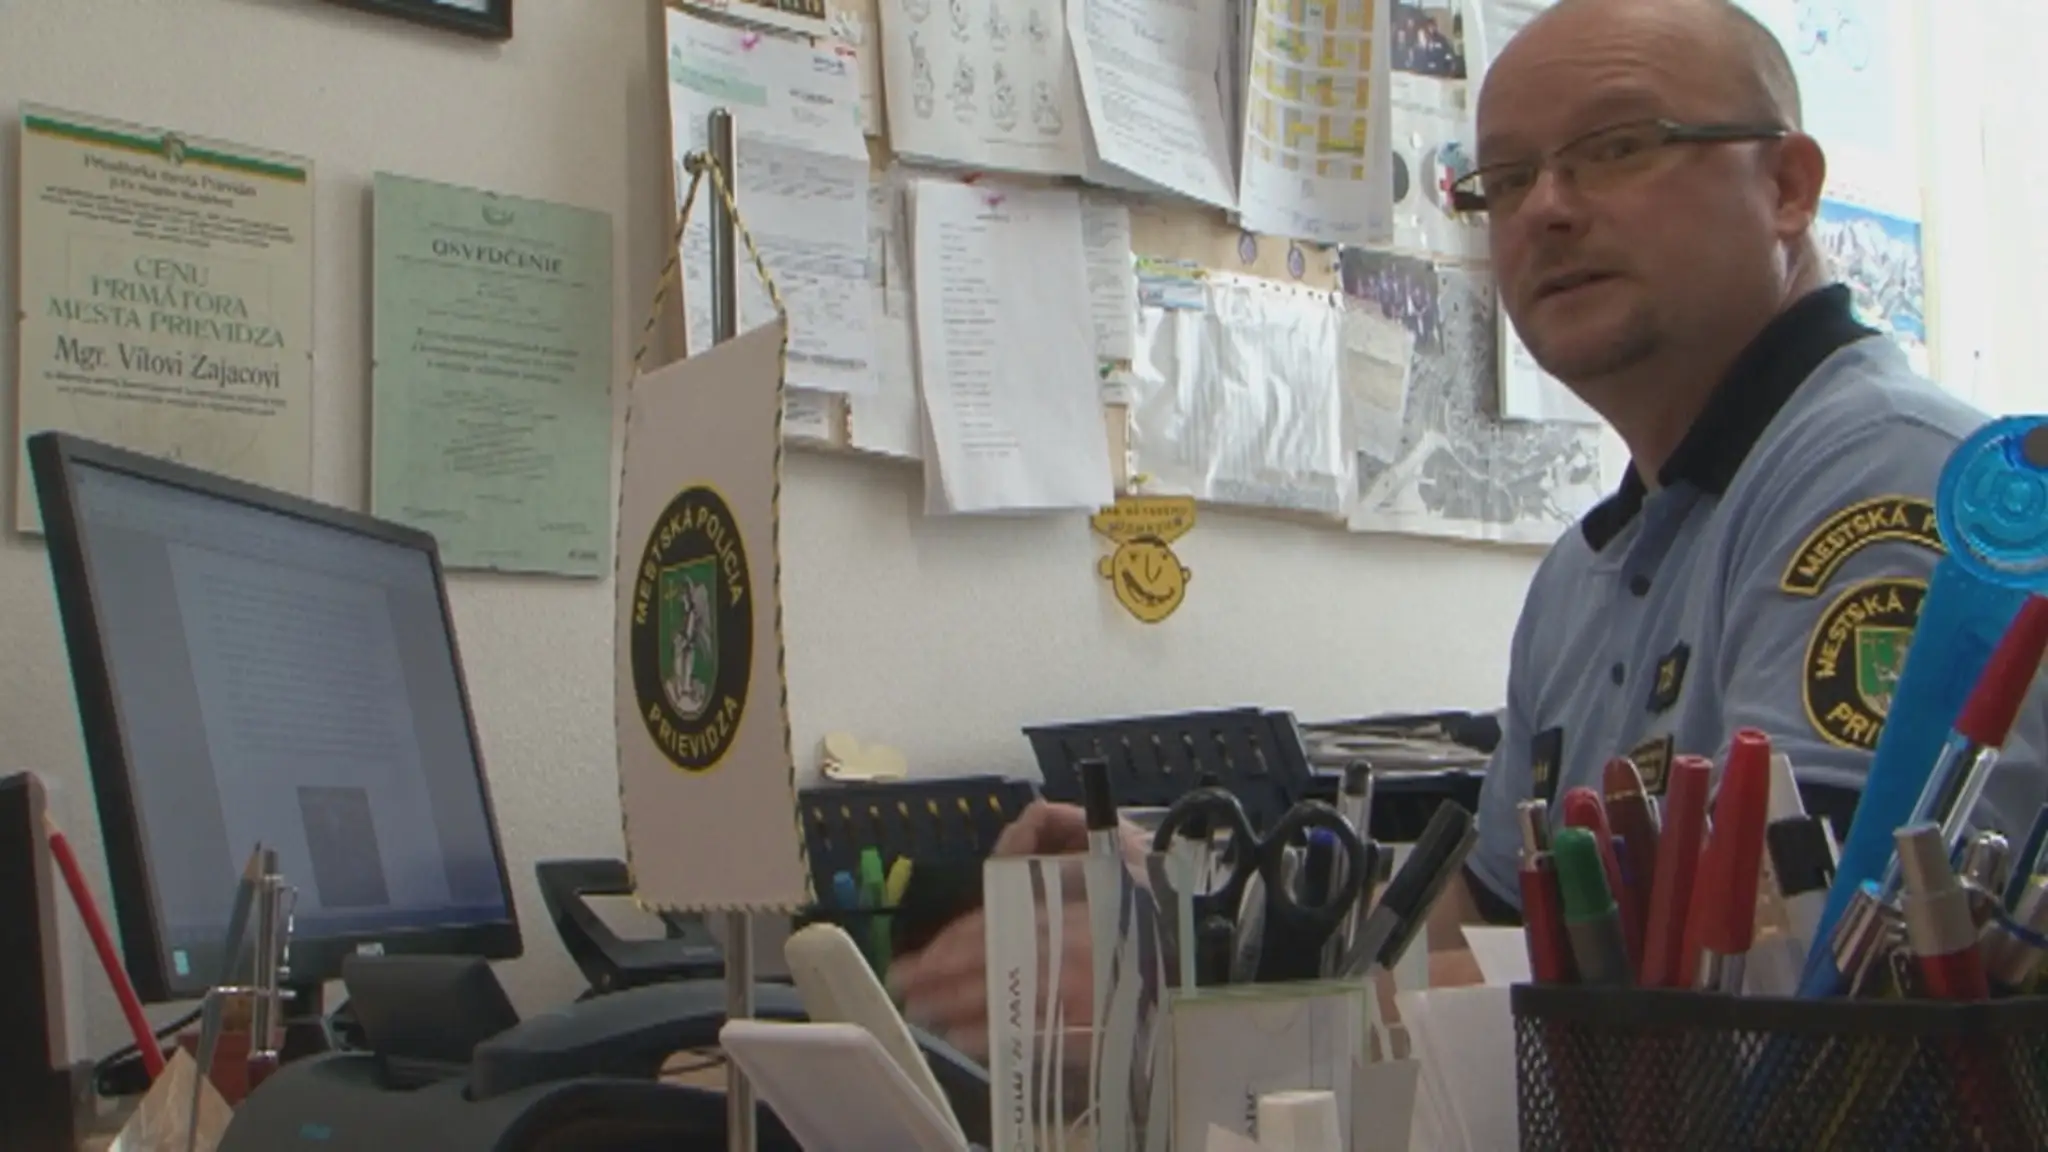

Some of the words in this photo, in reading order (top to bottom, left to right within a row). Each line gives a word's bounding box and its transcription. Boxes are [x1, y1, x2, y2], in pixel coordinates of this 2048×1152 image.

[134, 256, 210, 287] CENU
[432, 238, 563, 273] OSVEDČENIE
[47, 295, 142, 330] MESTA
[148, 312, 285, 349] PRIEVIDZA
[91, 273, 249, 319] PRIMÁTORA
[54, 333, 109, 371] Mgr.
[191, 350, 281, 389] Zajacovi
[636, 504, 692, 624] MESTSKÁ
[1798, 504, 1908, 578] MESTSKÁ
[1817, 589, 1904, 679] MESTSKÁ
[647, 696, 738, 760] PRIEVIDZA
